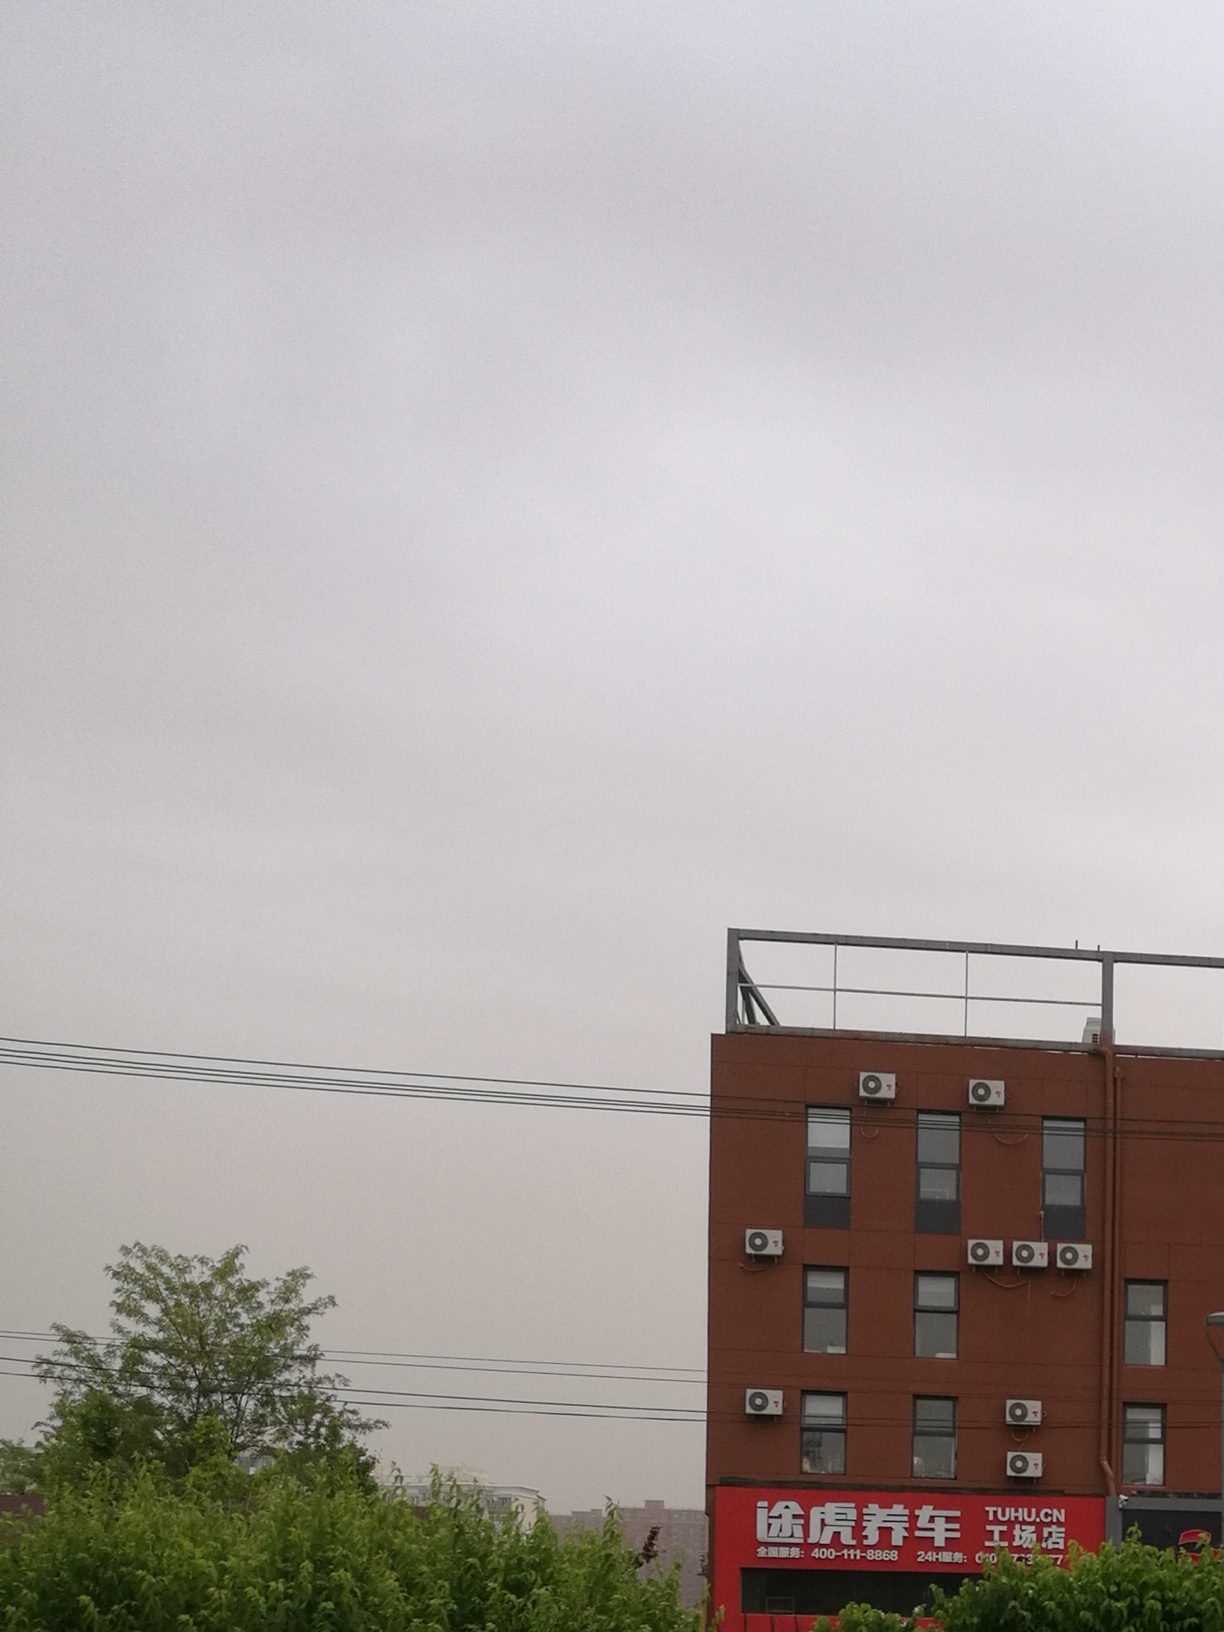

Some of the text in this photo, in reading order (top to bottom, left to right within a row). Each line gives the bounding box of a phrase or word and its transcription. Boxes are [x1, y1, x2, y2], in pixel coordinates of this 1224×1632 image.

[756, 1500, 961, 1548] 途虎养车
[984, 1506, 1065, 1523] TUHU.CN
[984, 1524, 1066, 1550] 工场店
[811, 1547, 899, 1562] 400-111-8868
